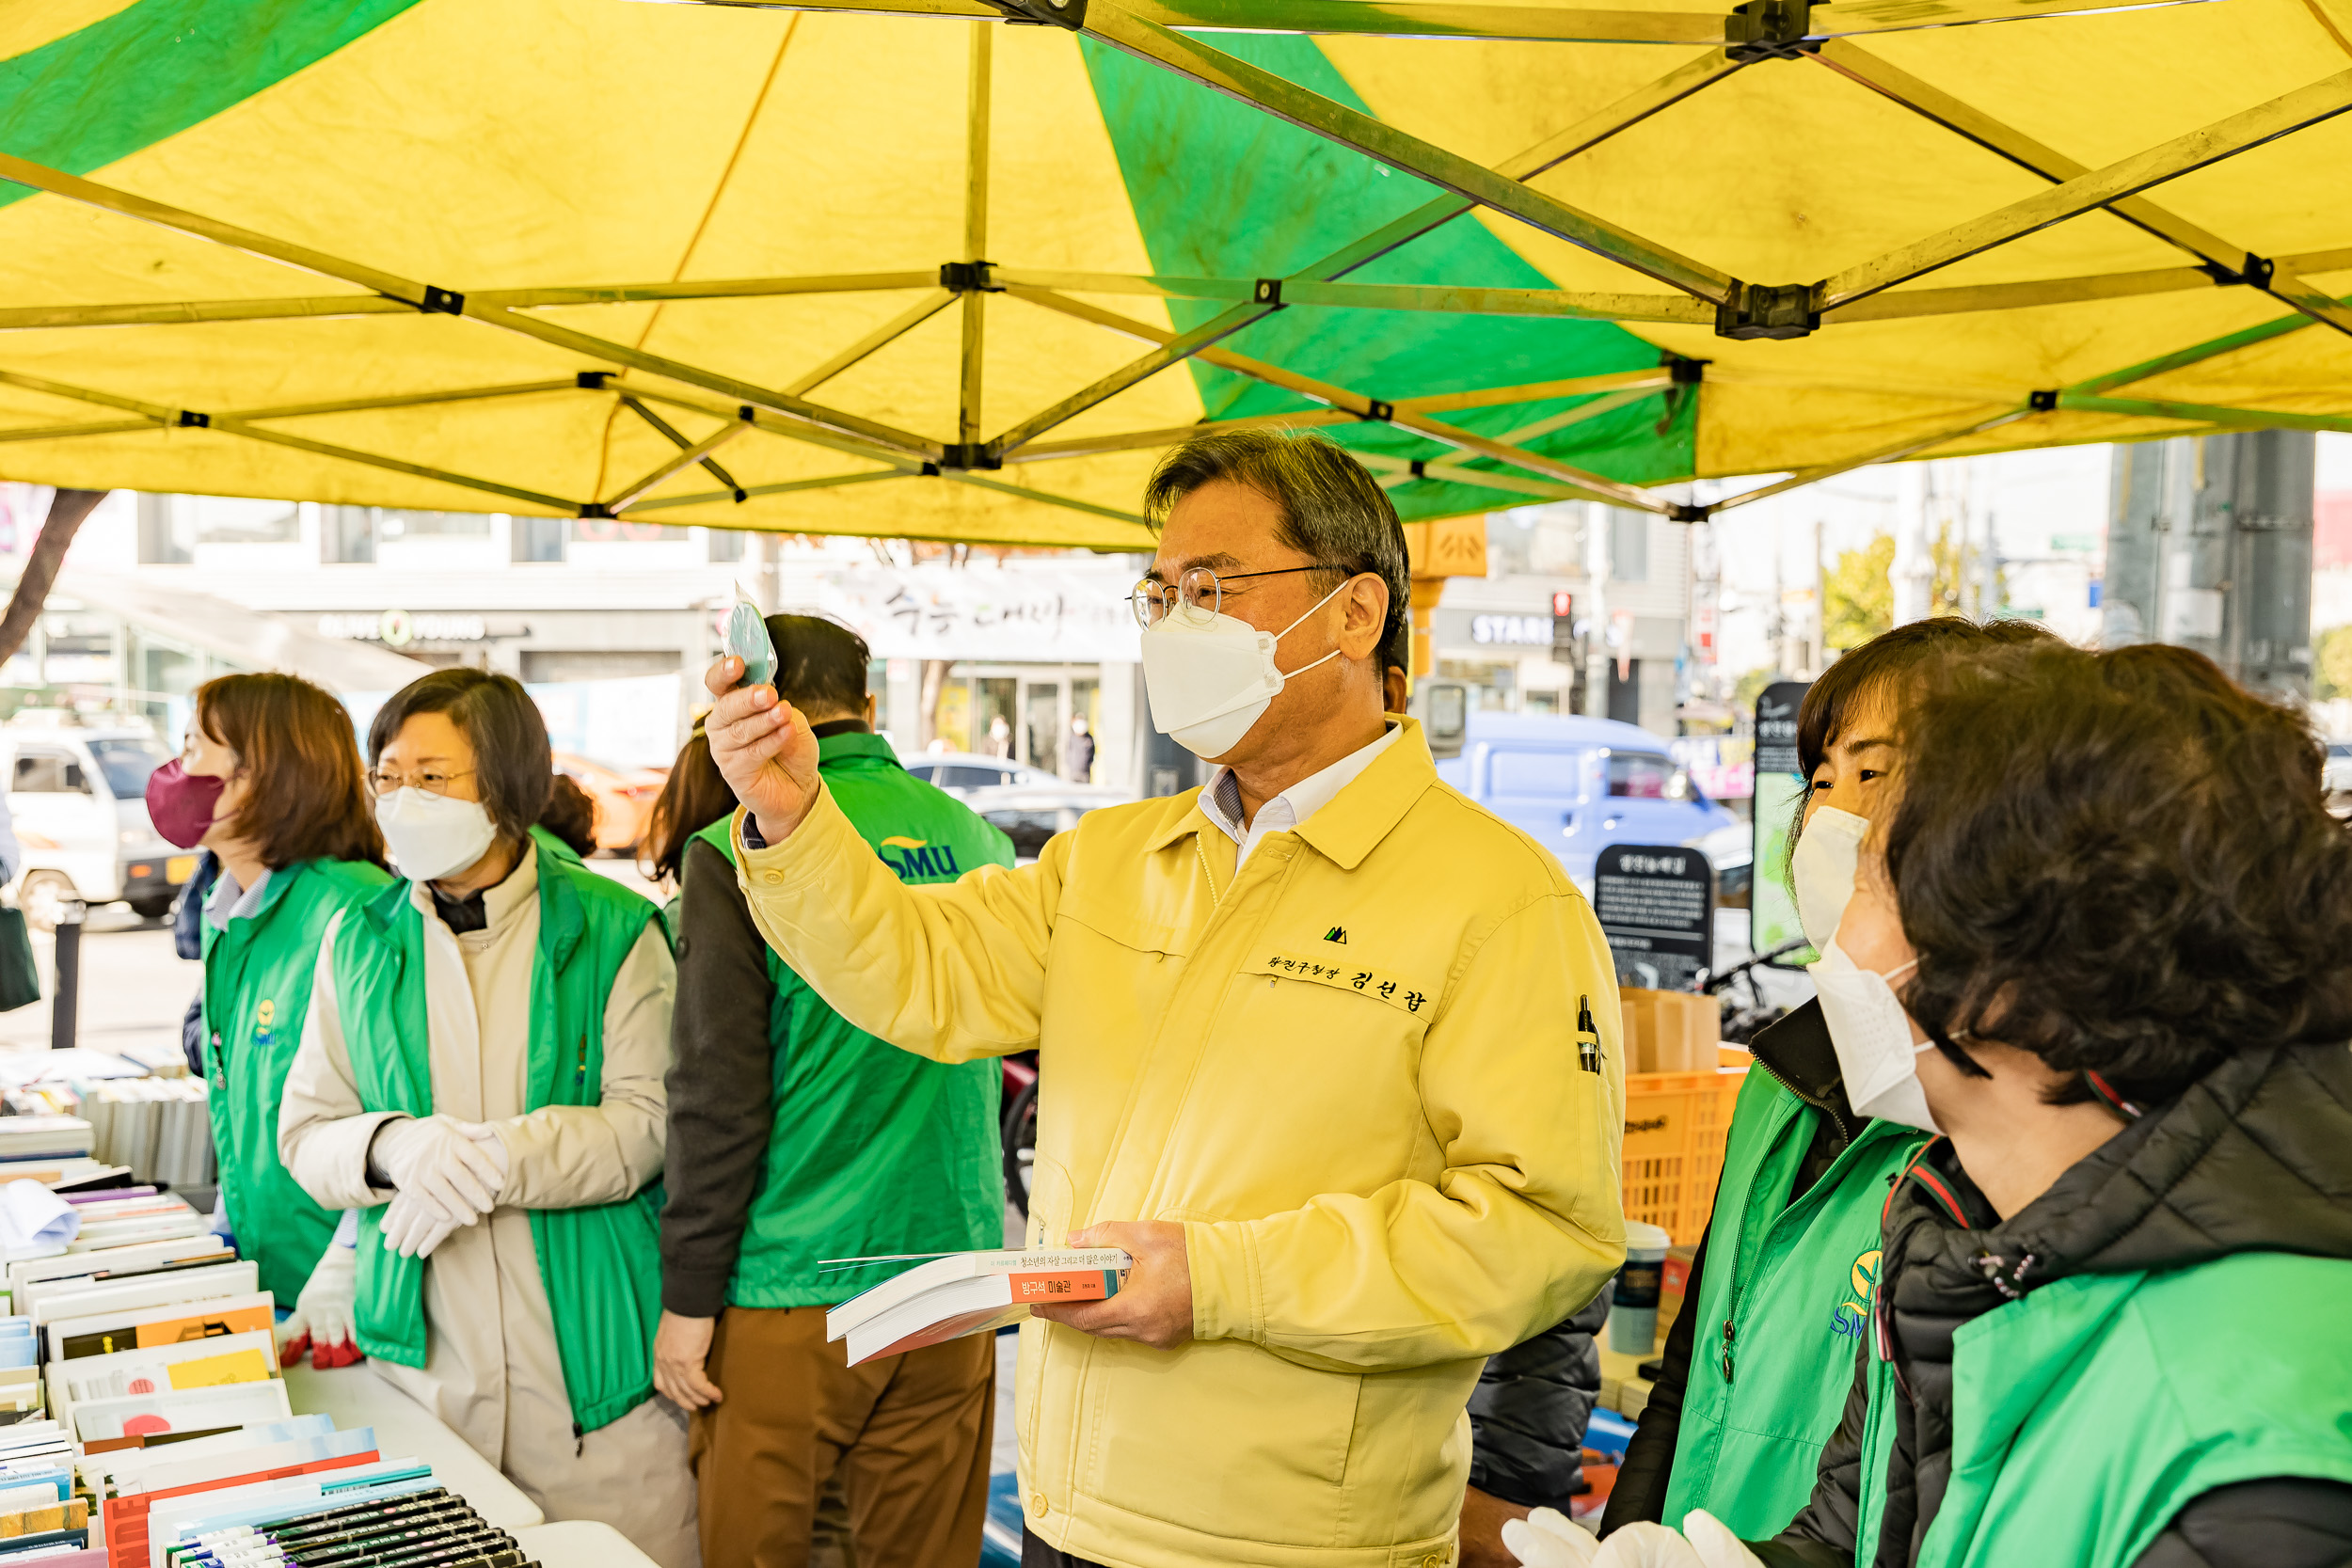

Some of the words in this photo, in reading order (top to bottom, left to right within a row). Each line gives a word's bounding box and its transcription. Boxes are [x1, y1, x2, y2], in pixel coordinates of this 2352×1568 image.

[878, 845, 960, 879] SMU
[1351, 972, 1427, 1012] 김선갑
[1021, 1256, 1046, 1268] 청소년의
[1047, 1255, 1060, 1266] 자살
[1061, 1255, 1078, 1265] 그리고
[1079, 1254, 1085, 1264] 더
[1086, 1254, 1099, 1265] 많은
[1100, 1253, 1118, 1264] 이야기
[1022, 1281, 1046, 1295] 방구석
[1048, 1280, 1071, 1293] 미술관
[1830, 1307, 1867, 1339] SM
